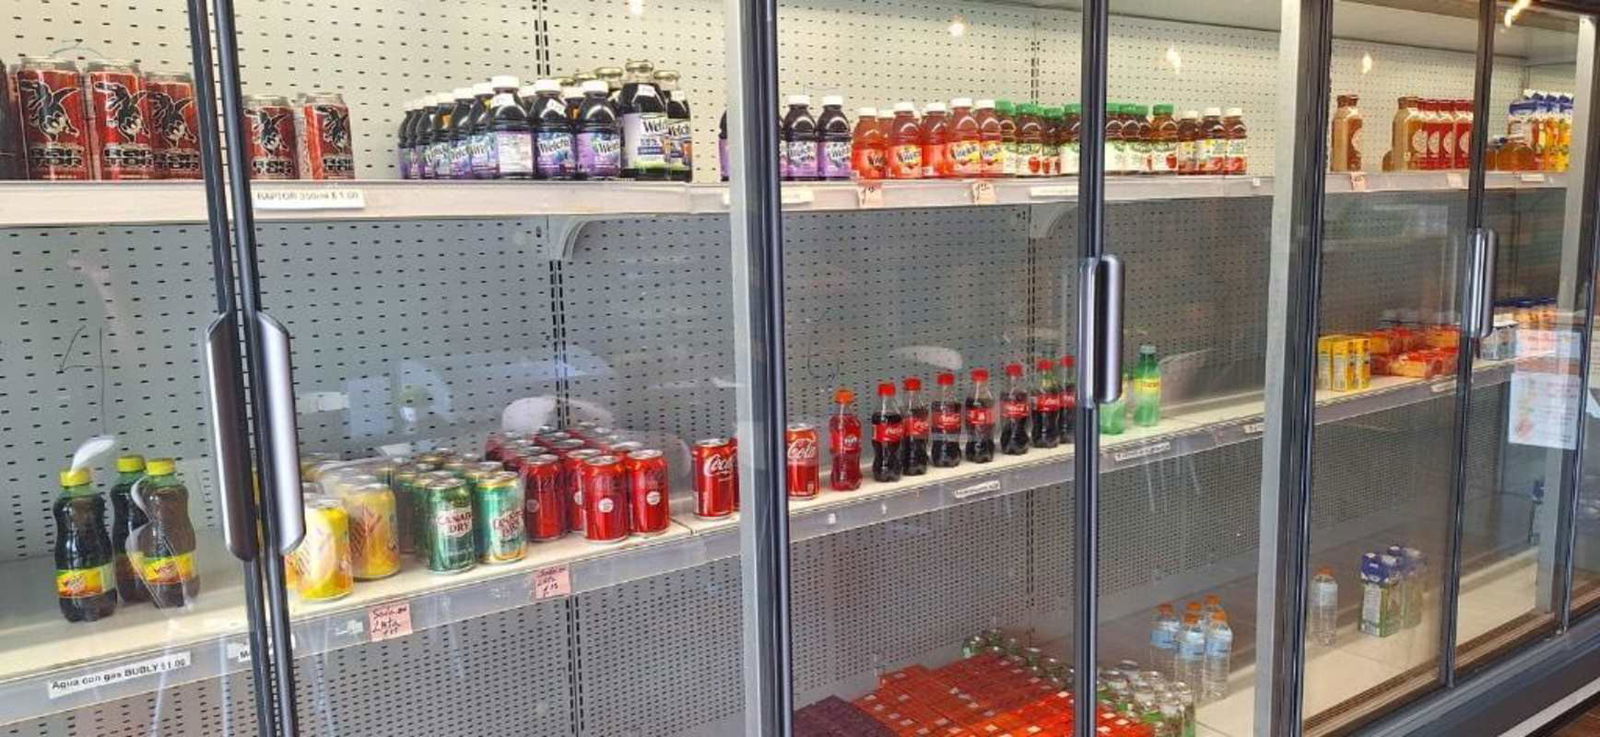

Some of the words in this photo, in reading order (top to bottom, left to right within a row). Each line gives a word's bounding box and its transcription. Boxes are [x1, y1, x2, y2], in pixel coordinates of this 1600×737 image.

[52, 679, 80, 691] Agua
[82, 675, 102, 685] con
[104, 672, 123, 682] gas
[124, 663, 158, 678] BUBLY
